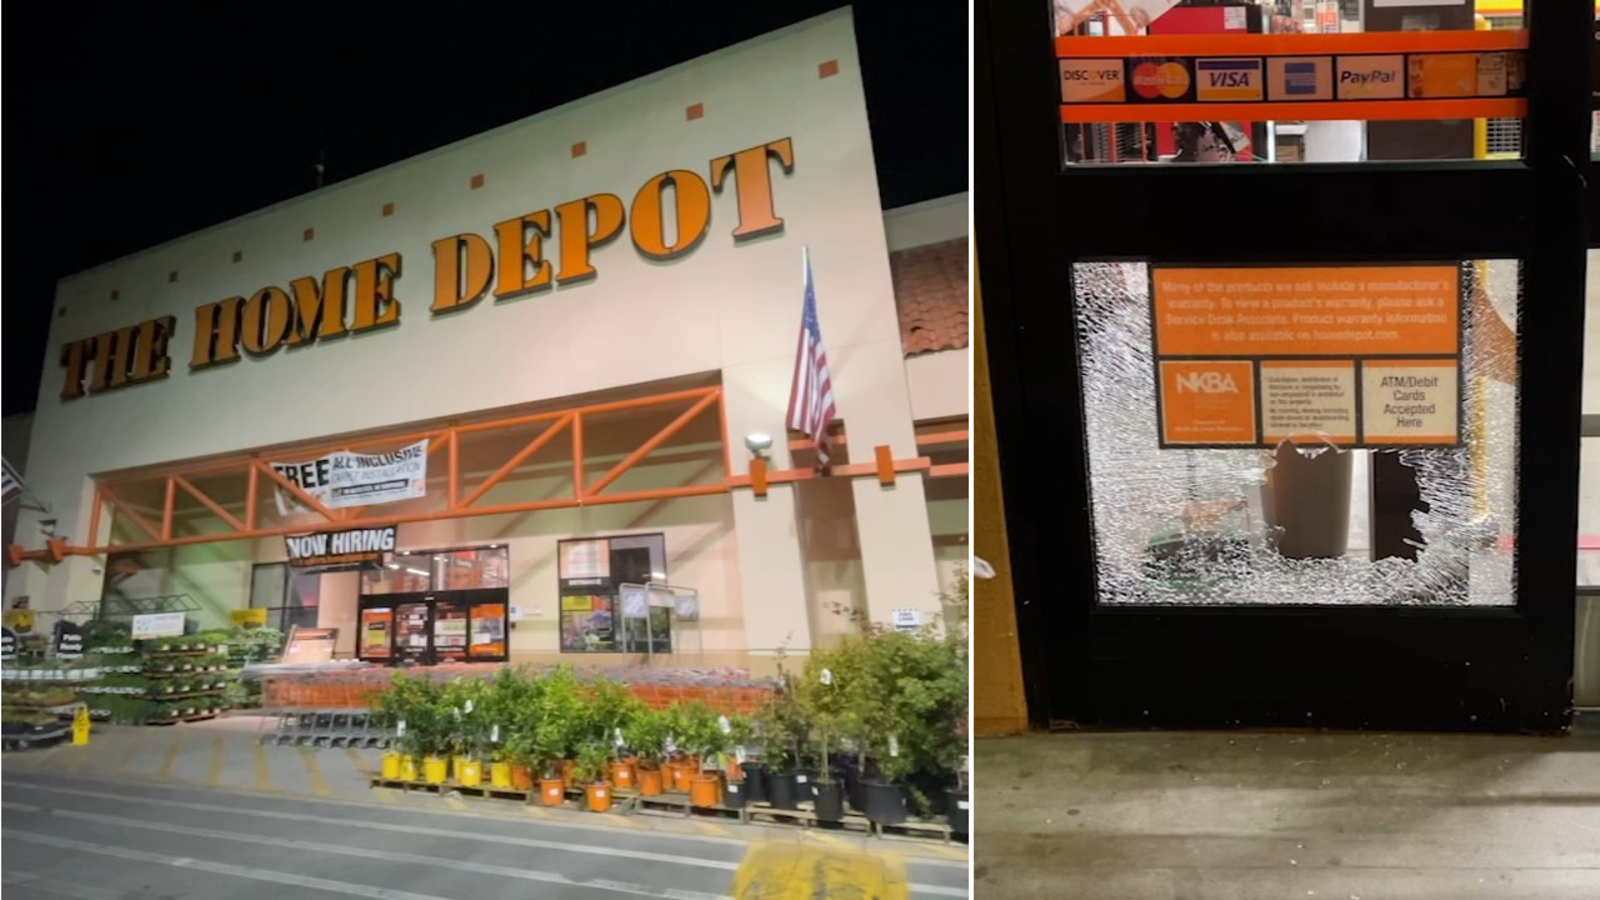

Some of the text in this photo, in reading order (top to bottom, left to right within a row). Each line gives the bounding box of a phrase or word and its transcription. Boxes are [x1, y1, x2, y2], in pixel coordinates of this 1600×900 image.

[1209, 72, 1250, 87] VISA
[1340, 70, 1396, 85] PayPal
[59, 137, 794, 401] THE HOME DEPOT
[1175, 371, 1239, 394] NKBA
[1380, 376, 1438, 388] ATM/Debit
[1393, 389, 1426, 401] Cards
[1383, 403, 1436, 416] Accepted
[1396, 417, 1424, 428] Here
[286, 528, 395, 559] NOW HIRING
